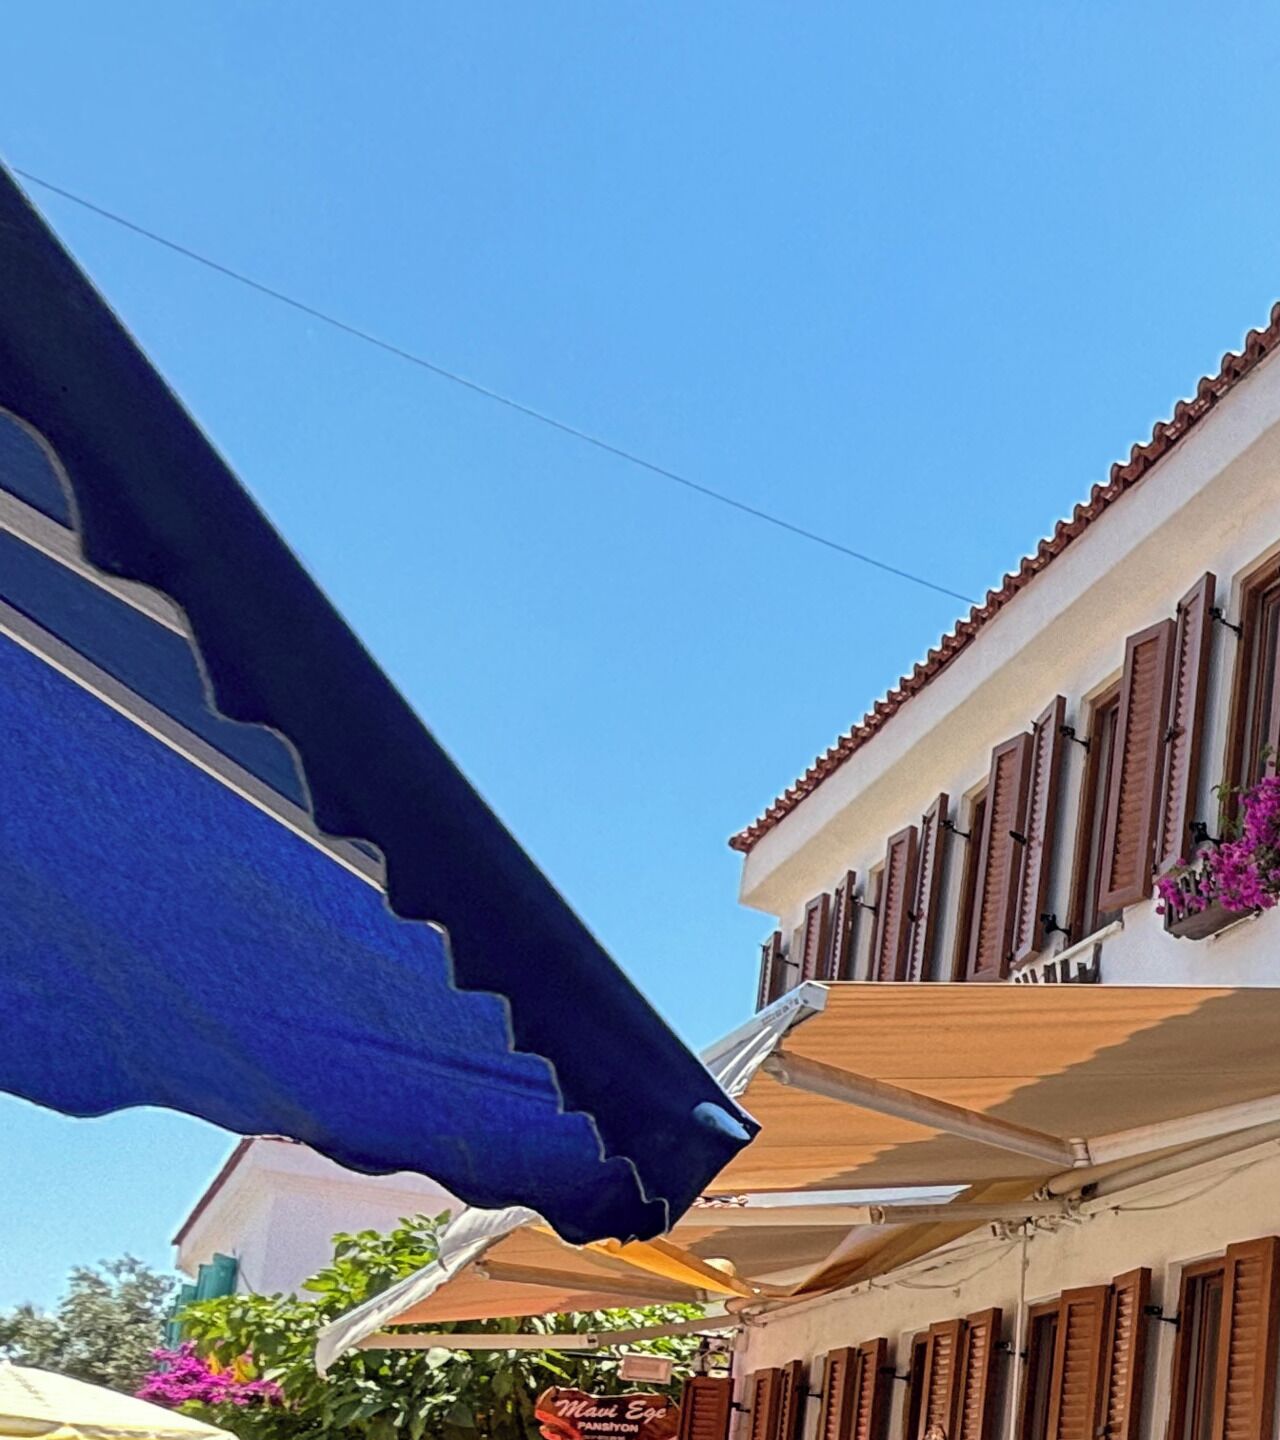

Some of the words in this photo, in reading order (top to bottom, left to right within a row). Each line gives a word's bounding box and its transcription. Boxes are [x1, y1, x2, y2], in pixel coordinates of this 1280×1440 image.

[554, 1399, 619, 1419] Mavi
[624, 1400, 668, 1425] Ege
[577, 1420, 639, 1433] PANSİYON
